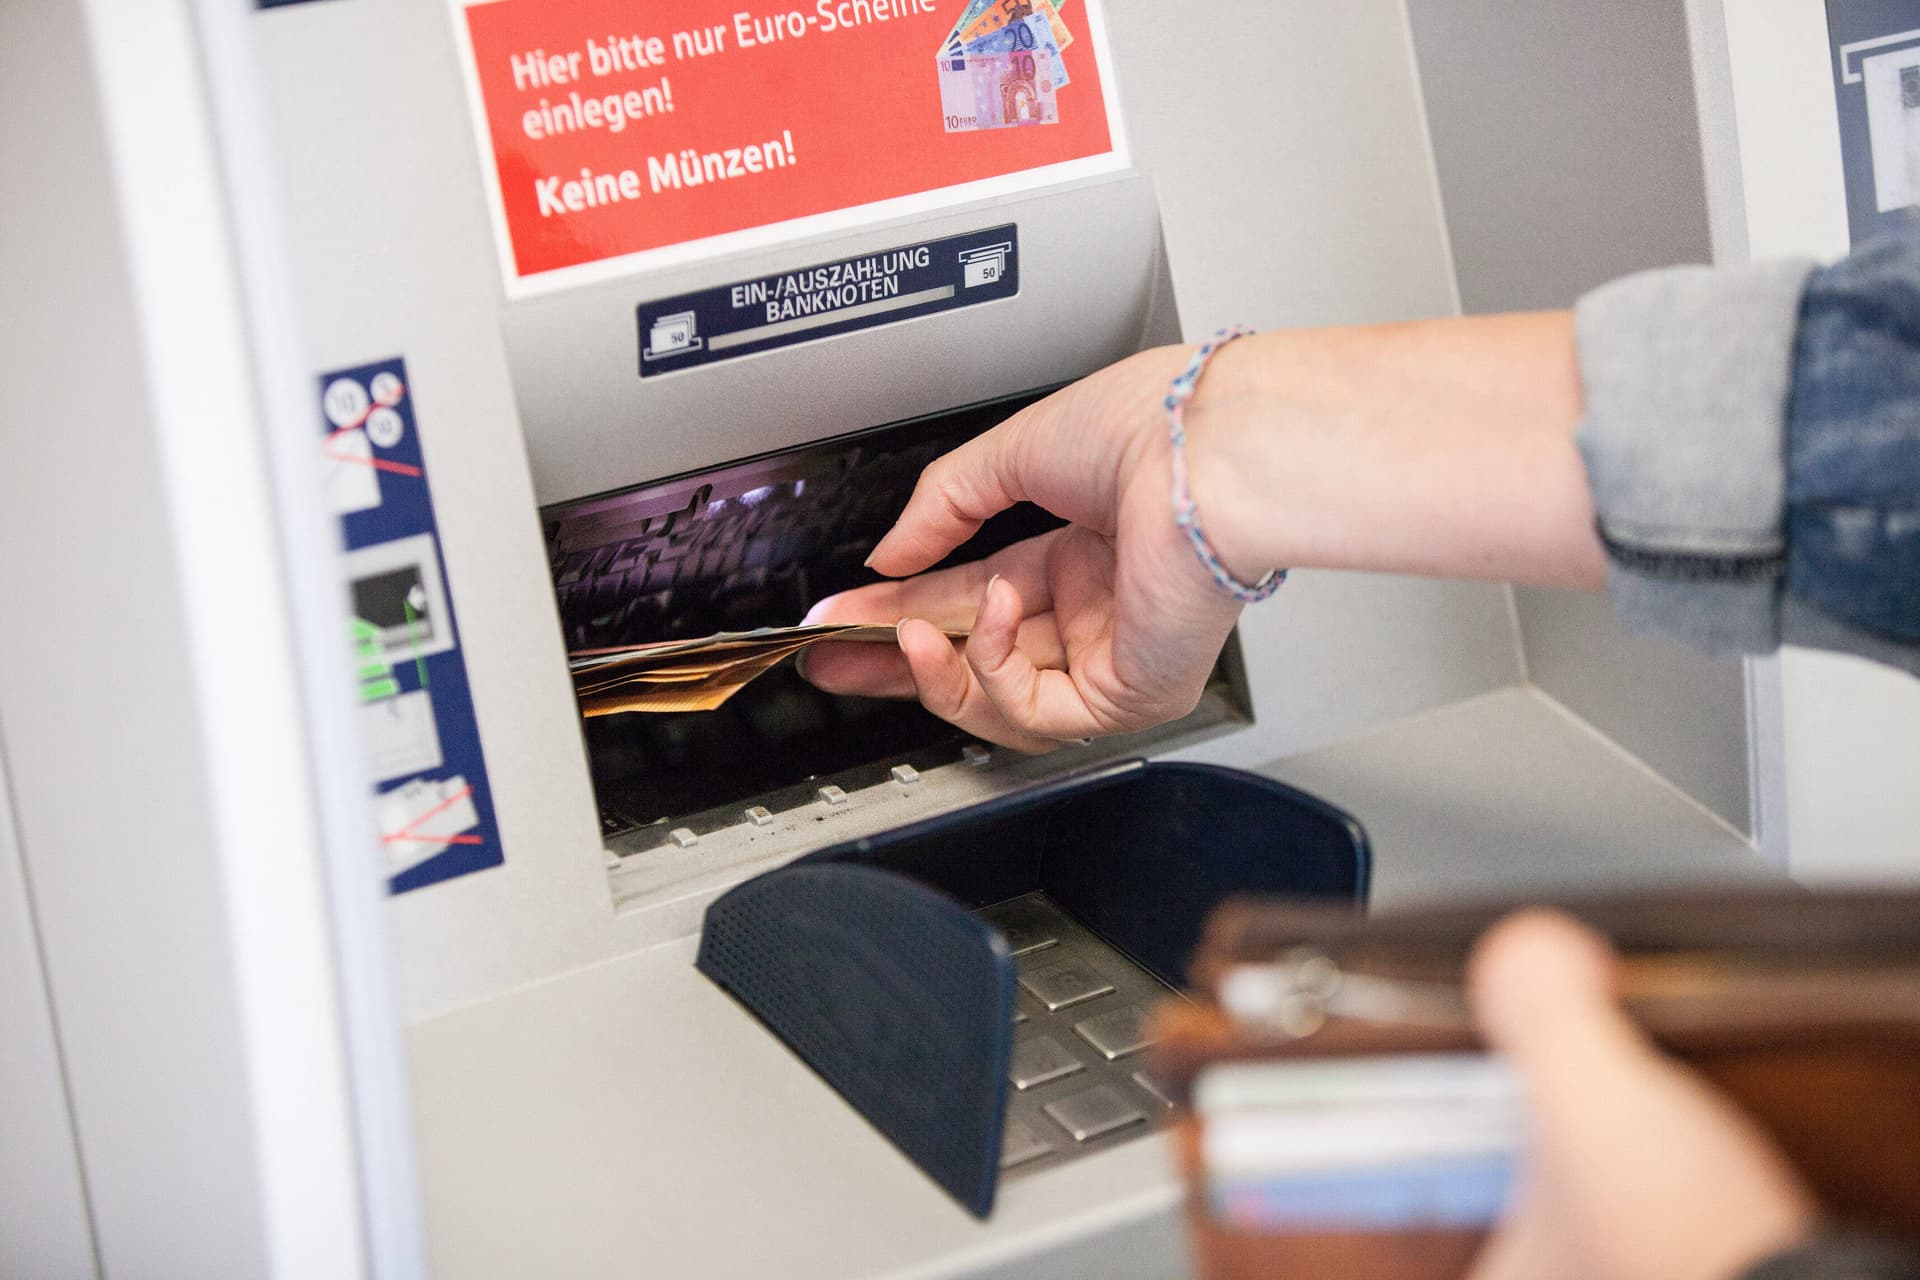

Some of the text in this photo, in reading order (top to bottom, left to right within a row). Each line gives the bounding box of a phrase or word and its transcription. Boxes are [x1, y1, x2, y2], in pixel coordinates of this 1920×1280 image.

[510, 0, 936, 92] Hier bitte nur Euro-Scheine
[1010, 53, 1036, 82] 10
[522, 76, 675, 139] einlegen!
[945, 115, 960, 130] 10
[534, 129, 797, 217] Keine Münzen!
[731, 246, 930, 309] EIN-/AUSZAHLUNG
[766, 274, 899, 323] BANKNOTEN
[983, 266, 996, 279] 50
